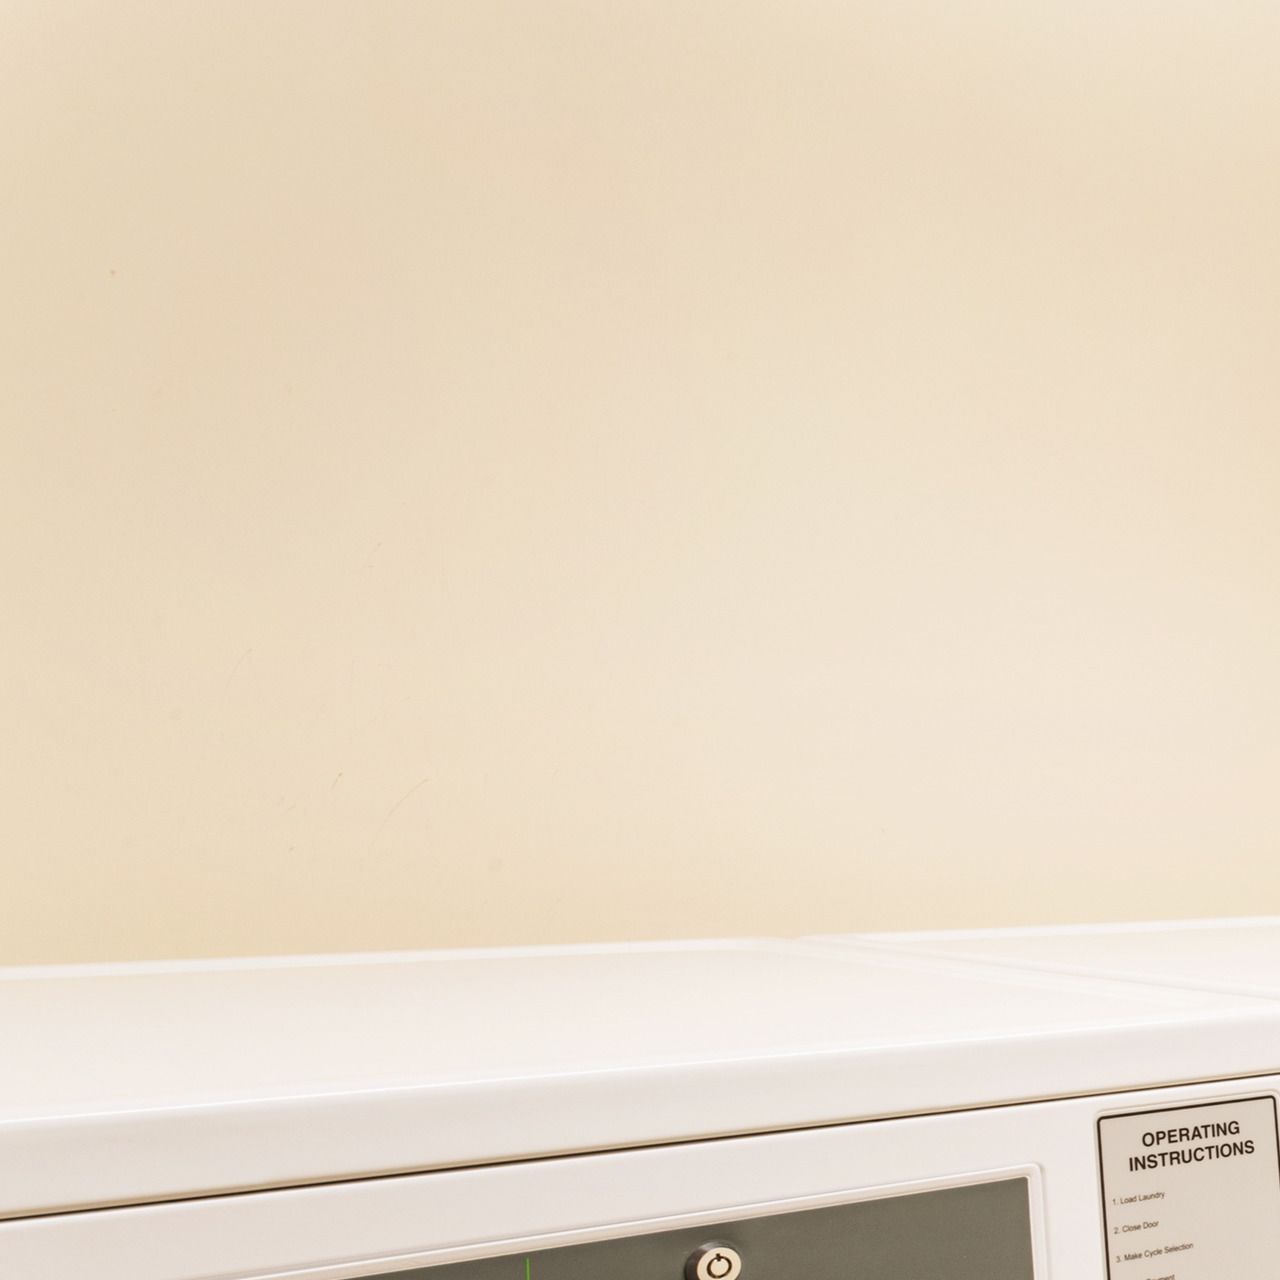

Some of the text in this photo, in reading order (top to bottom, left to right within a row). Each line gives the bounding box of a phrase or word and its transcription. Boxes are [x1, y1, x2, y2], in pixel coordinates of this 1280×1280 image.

[1142, 1121, 1240, 1147] OPERATING
[1129, 1140, 1255, 1172] INSTRUCTIONS
[1120, 1195, 1137, 1204] Load
[1139, 1192, 1165, 1201] Laundry
[1122, 1224, 1141, 1233] Close
[1143, 1221, 1159, 1229] Door
[1124, 1252, 1142, 1261] Make
[1144, 1249, 1162, 1258] Cycle
[1164, 1243, 1194, 1254] Selection
